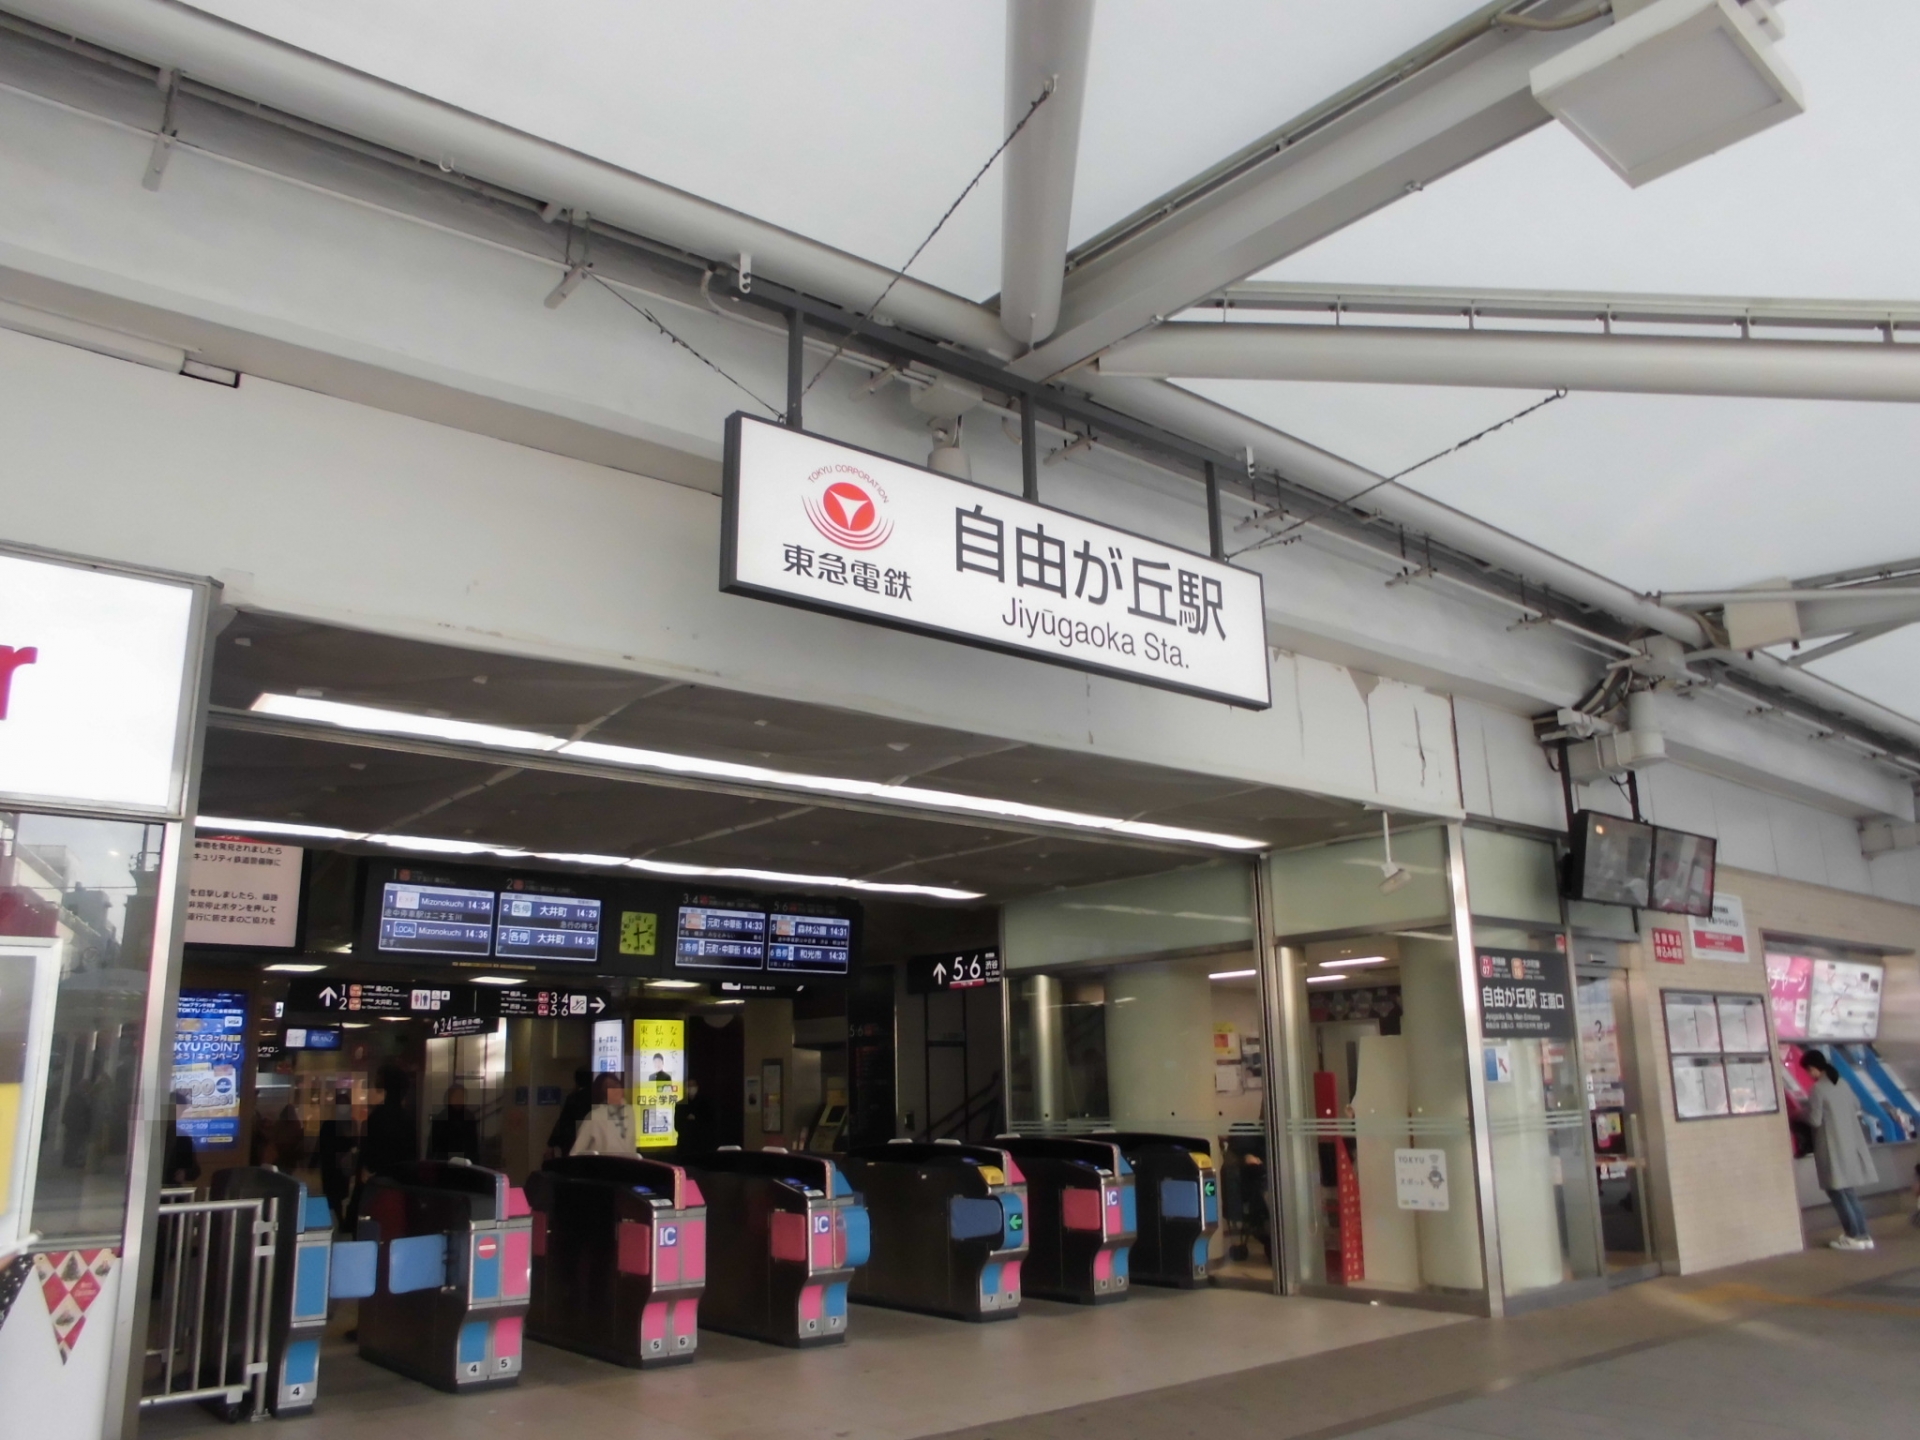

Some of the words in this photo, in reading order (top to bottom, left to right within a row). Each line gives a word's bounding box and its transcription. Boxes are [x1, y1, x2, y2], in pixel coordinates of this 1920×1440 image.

[807, 464, 833, 484] TOKYU
[835, 464, 890, 504] CORPORATION
[782, 543, 913, 602] 東急電鉄
[955, 503, 1227, 642] 自由が丘駅
[1001, 597, 1137, 657] Jiyūgaoka
[1144, 632, 1190, 670] Sta.
[421, 898, 465, 909] Mizonokuchi
[468, 900, 491, 911] 14:34
[503, 904, 509, 912] 2
[540, 906, 568, 918] 大井町
[577, 908, 598, 919] 14:29
[395, 925, 415, 934] LOCAL
[418, 927, 463, 937] Mizonokuchi
[466, 929, 488, 940] 14:36
[744, 921, 763, 931] 14:33
[830, 927, 847, 937] 14:31
[501, 932, 507, 940] 2
[510, 932, 529, 942] 各停
[537, 933, 565, 945] 大井町
[743, 946, 762, 956] 14:34
[1482, 966, 1490, 975] 07
[341, 984, 346, 996] 1
[338, 997, 348, 1010] 2
[1482, 985, 1538, 1010] 自由が丘駅
[1539, 991, 1565, 1010] 正面口
[202, 1042, 241, 1052] POINT
[637, 1094, 679, 1106] 四谷学院
[1398, 1155, 1425, 1165] TOKYU
[1106, 1191, 1118, 1206] IC
[814, 1215, 829, 1234] IC
[659, 1226, 678, 1246] IC
[809, 1321, 815, 1329] 6
[832, 1317, 837, 1326] 7
[653, 1340, 659, 1349] 5
[679, 1337, 685, 1346] 6
[470, 1364, 477, 1373] 4
[501, 1359, 507, 1368] 5
[292, 1386, 300, 1396] 4
